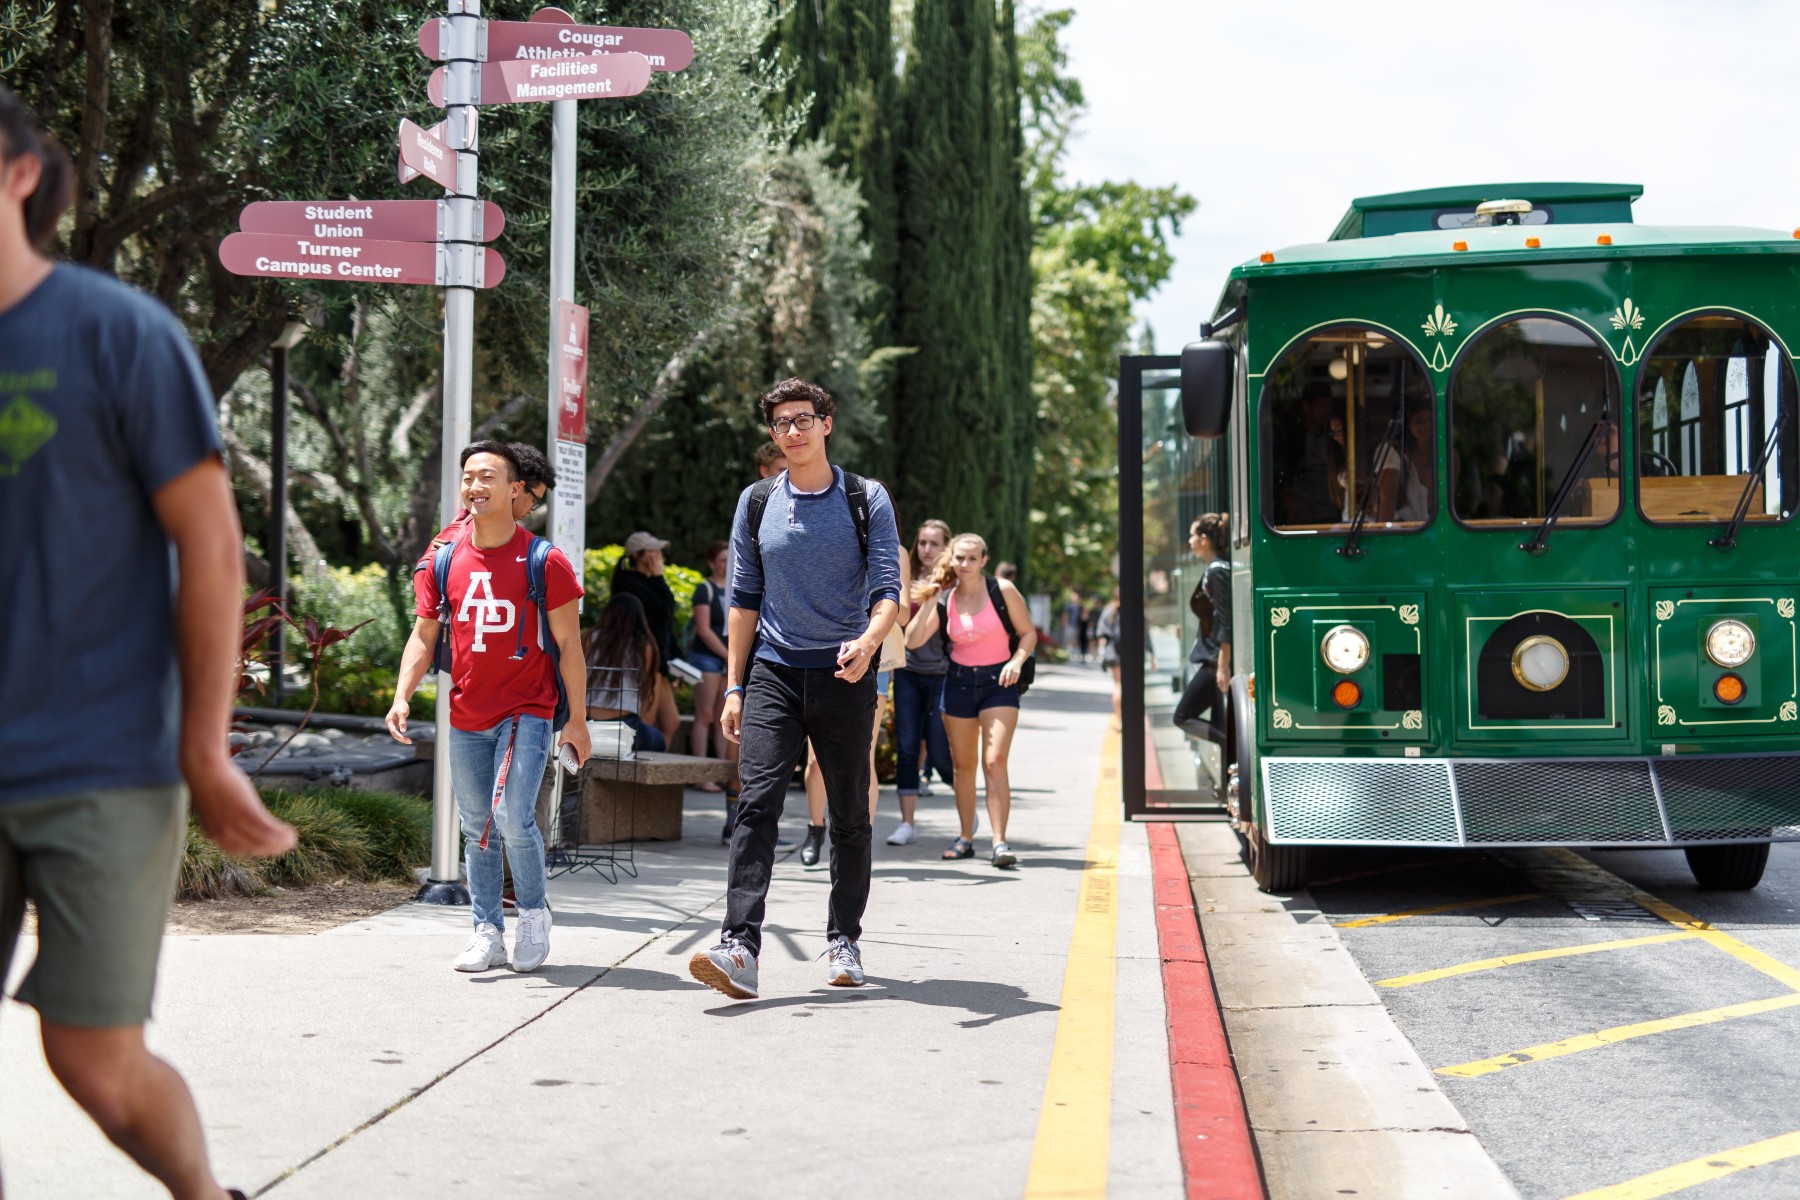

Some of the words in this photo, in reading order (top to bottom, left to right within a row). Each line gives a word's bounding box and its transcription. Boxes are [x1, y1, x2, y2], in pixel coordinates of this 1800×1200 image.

[558, 29, 623, 48] Cougar
[530, 61, 598, 78] Facilities
[516, 78, 612, 98] Management
[416, 131, 443, 160] Residence
[423, 155, 437, 175] Halls
[304, 205, 373, 220] Student
[314, 223, 363, 238] Union
[297, 240, 361, 258] Turner
[255, 256, 332, 276] Campus
[337, 261, 402, 278] Center
